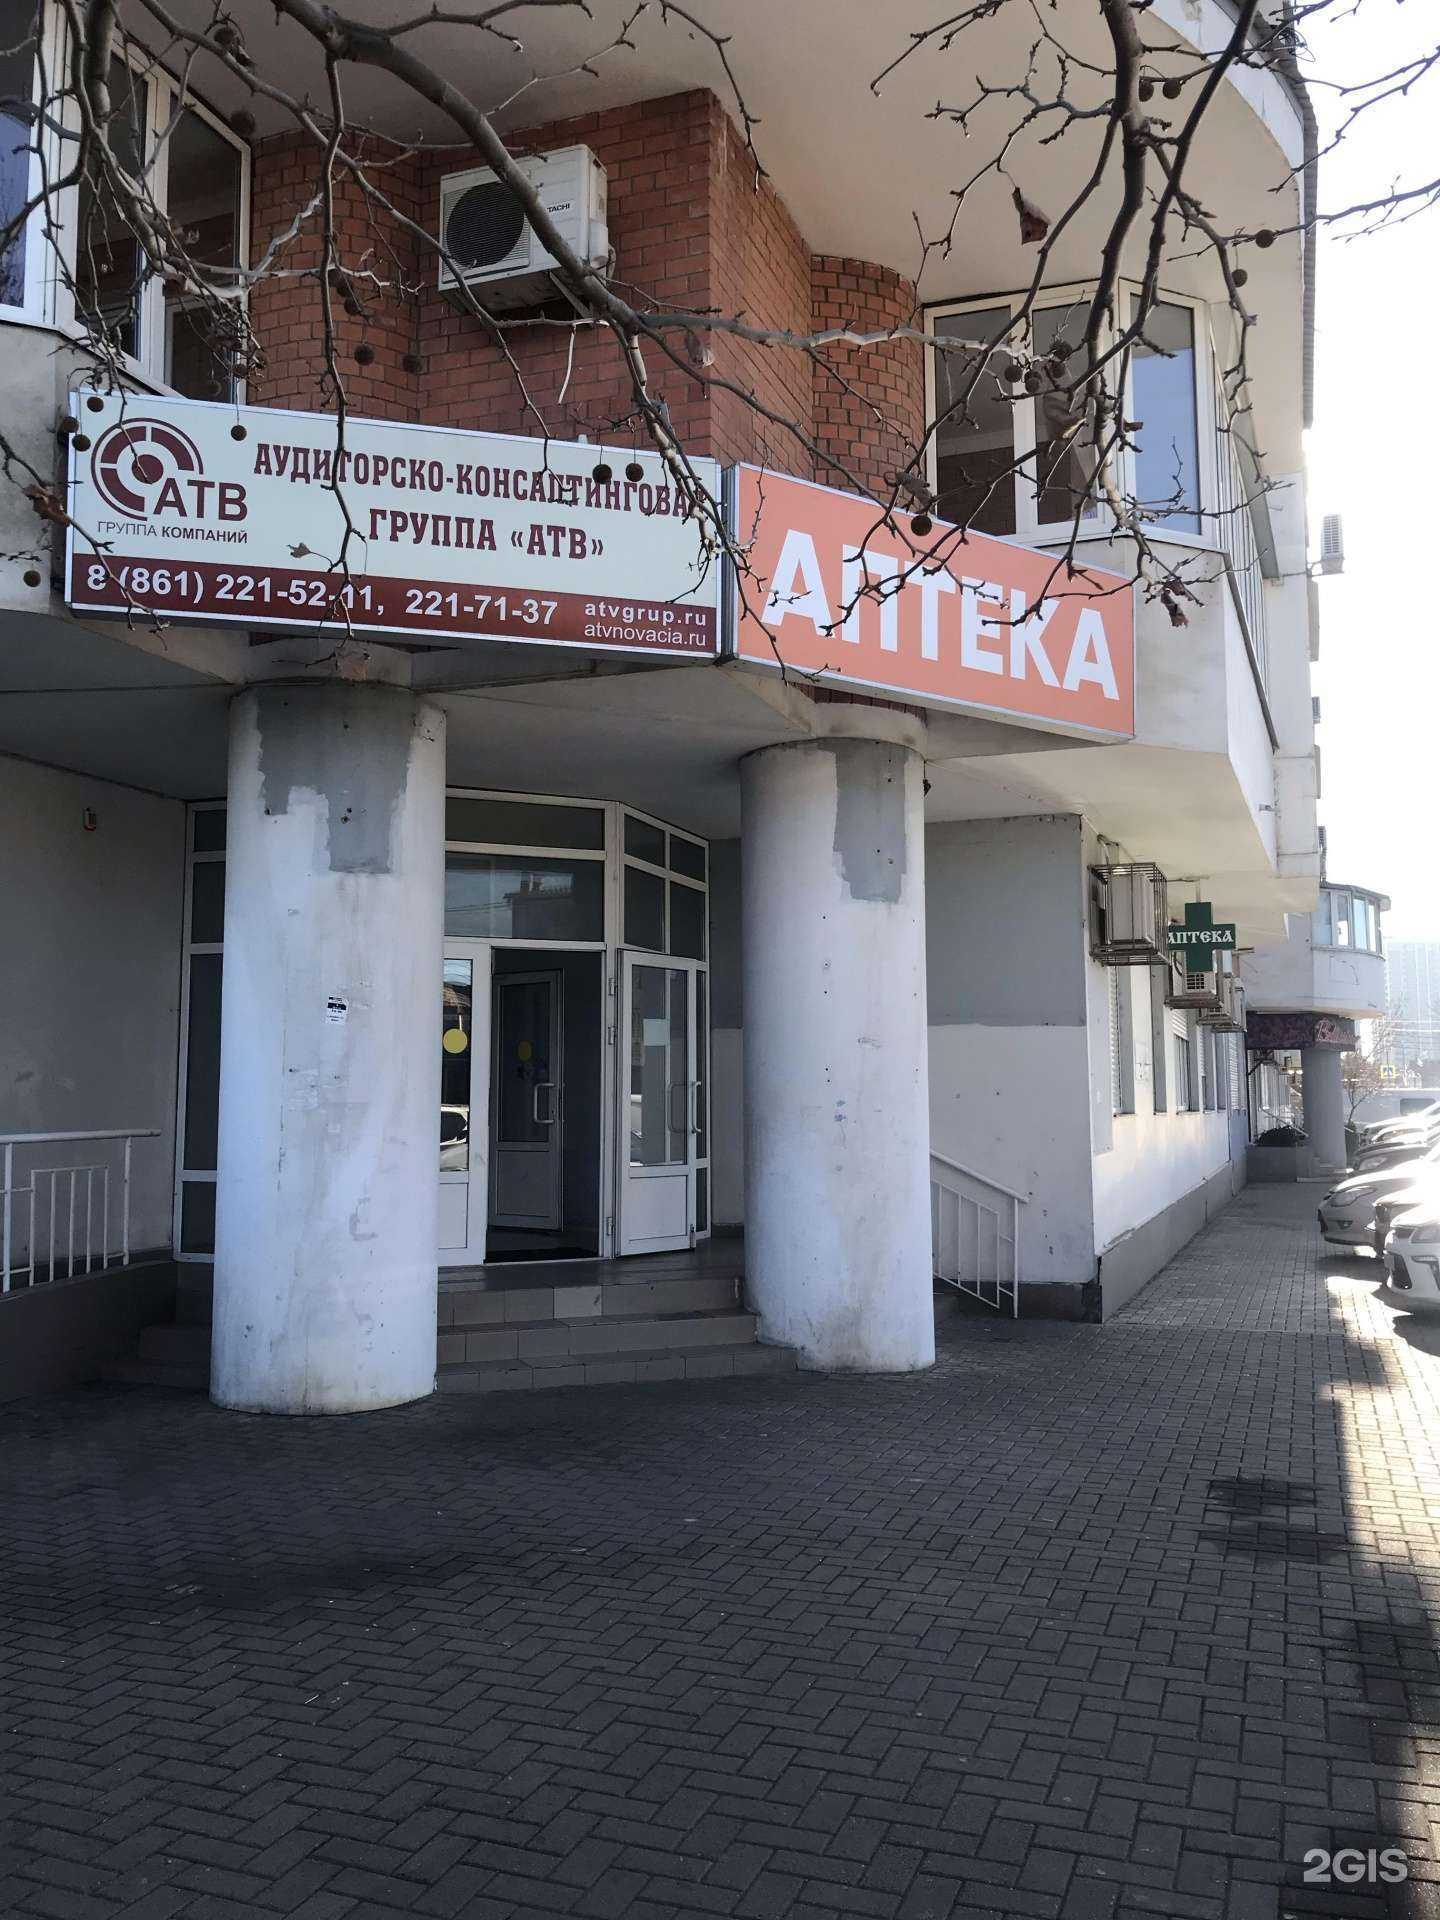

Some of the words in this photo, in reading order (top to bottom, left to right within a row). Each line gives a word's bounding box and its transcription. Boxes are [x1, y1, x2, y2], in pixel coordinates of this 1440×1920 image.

[152, 477, 248, 522] АТВ
[97, 520, 158, 537] ГРУППА
[161, 522, 248, 544] КОМПАНИЙ
[369, 508, 497, 551] ГРУППА
[510, 523, 604, 560] «АТВ»
[87, 564, 106, 591] 8
[119, 565, 204, 604] (861)
[215, 573, 384, 616] 221-52-11,
[405, 588, 559, 626] 221-71-37
[584, 601, 707, 627] atvgrup.ru
[762, 529, 1120, 701] АПТЕКА
[584, 622, 707, 647] atvnovacia.ru
